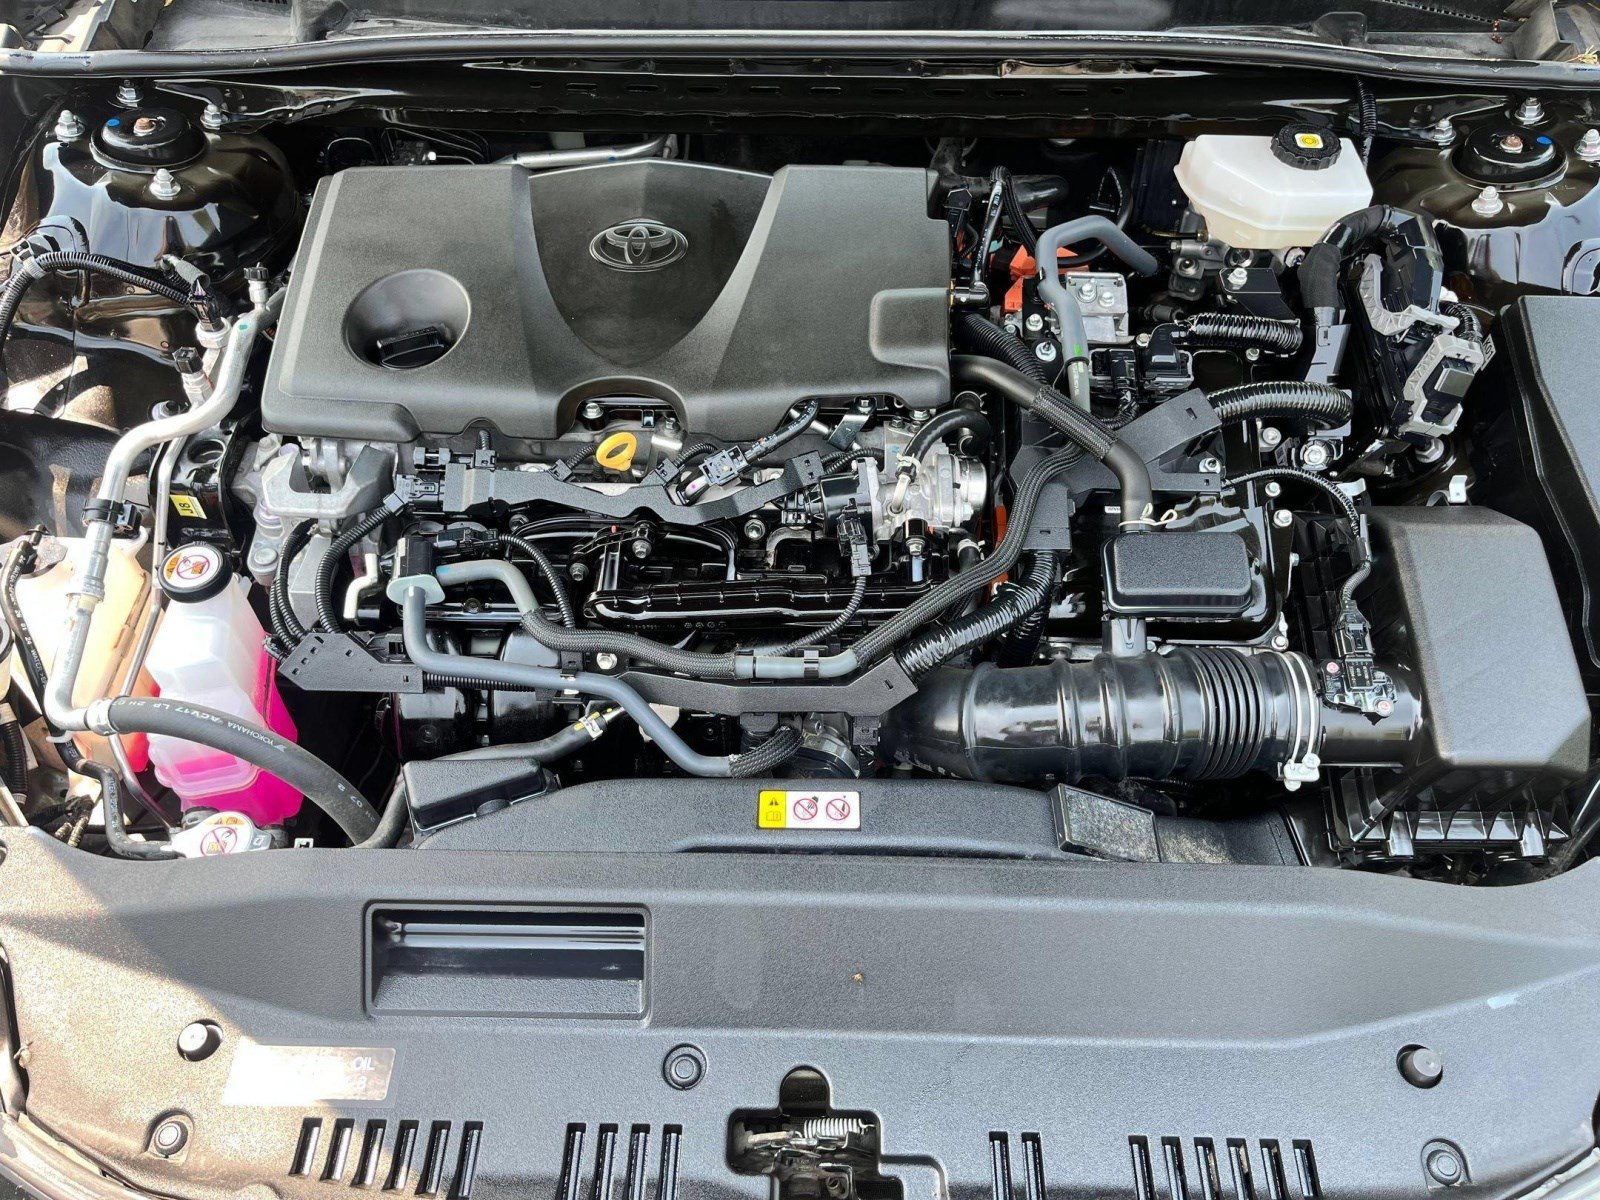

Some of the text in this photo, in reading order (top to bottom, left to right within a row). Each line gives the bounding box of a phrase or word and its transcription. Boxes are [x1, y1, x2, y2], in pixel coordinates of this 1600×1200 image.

[1483, 338, 1493, 360] K01
[178, 502, 194, 514] J8
[31, 648, 42, 673] WATER
[153, 702, 170, 710] LP
[227, 720, 275, 747] YOKOHAMA
[352, 1056, 376, 1071] OIL
